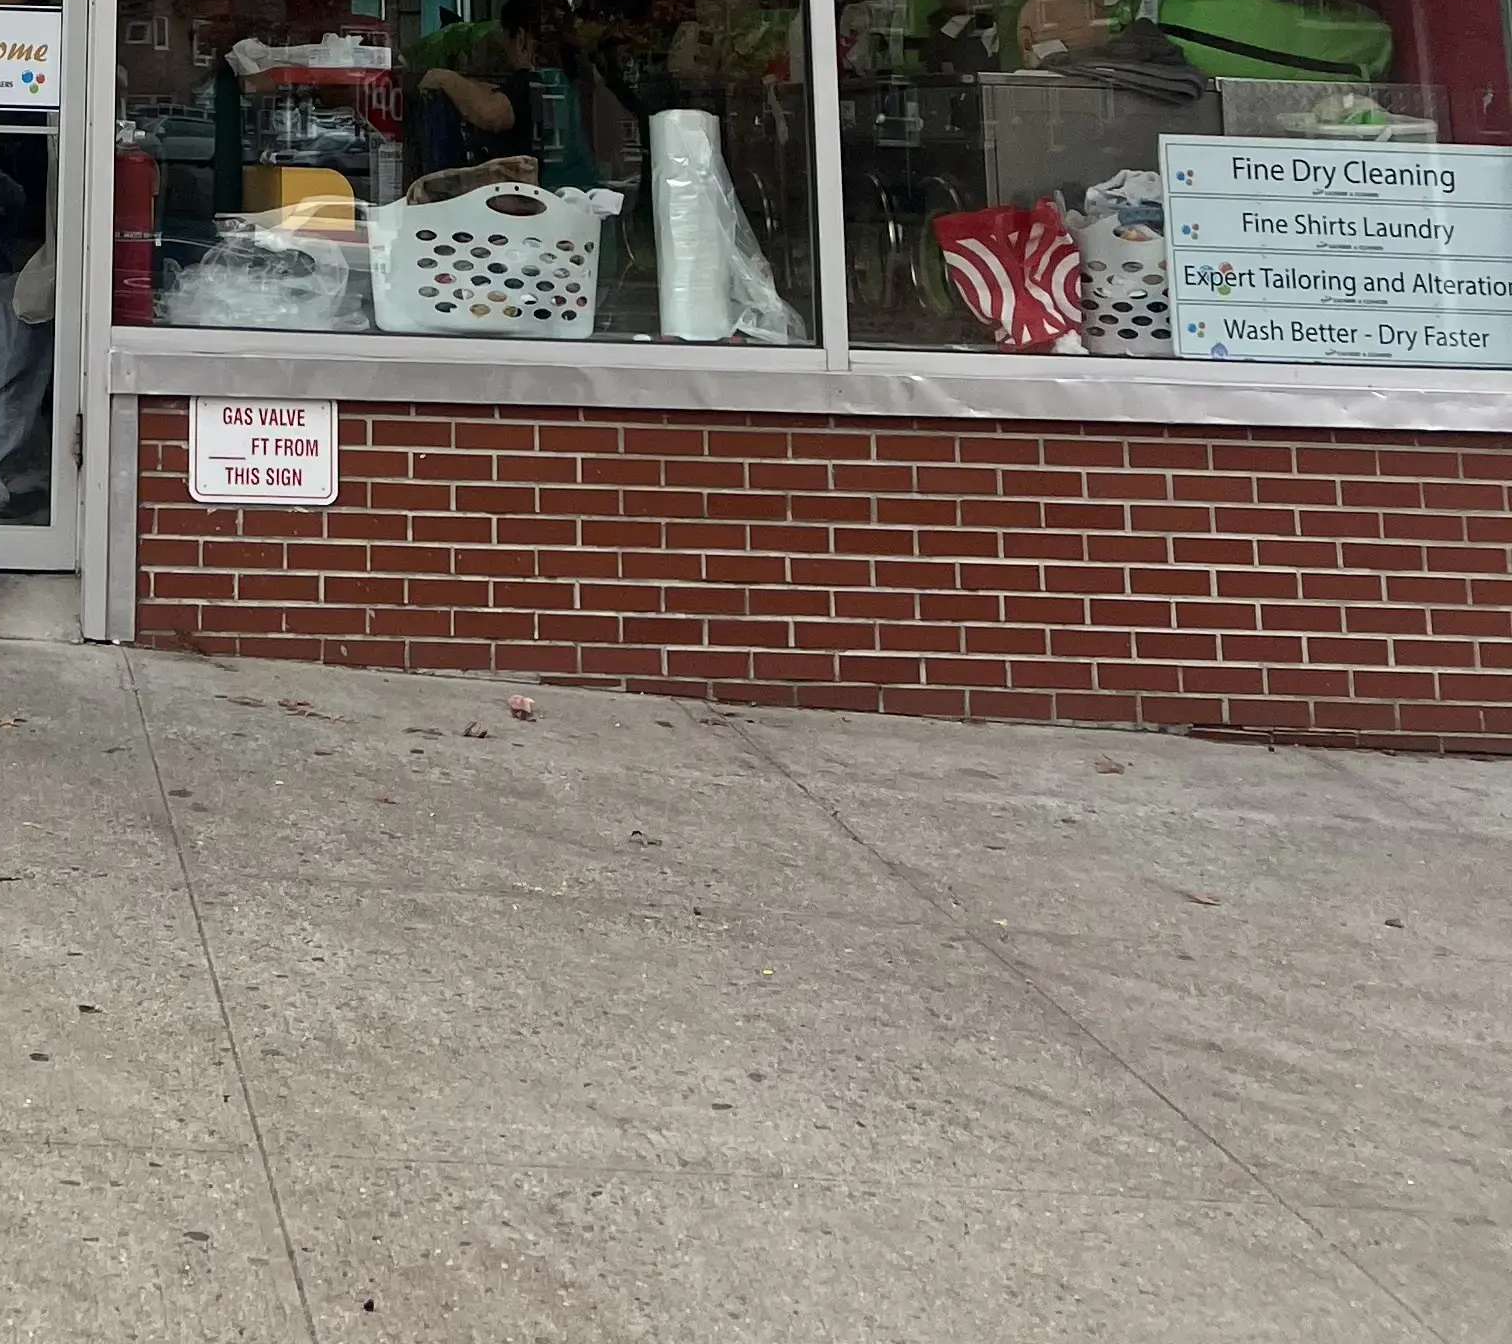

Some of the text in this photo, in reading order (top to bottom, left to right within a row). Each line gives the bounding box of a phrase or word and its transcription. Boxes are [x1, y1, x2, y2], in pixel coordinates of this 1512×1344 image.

[1232, 156, 1456, 193] Fine Dry Cleaning
[1242, 212, 1455, 245] Fine Shirts Laundry
[1184, 263, 1256, 292] Expert
[1260, 267, 1357, 296] Tailoring
[1363, 271, 1405, 293] and
[1223, 318, 1284, 341] Wash
[1291, 321, 1358, 344] Better
[1378, 324, 1418, 352] Dry
[1424, 325, 1490, 348] Faster
[223, 406, 306, 427] GAS VALVE
[251, 437, 319, 457] FT FROM
[225, 466, 303, 486] THIS SIGN
